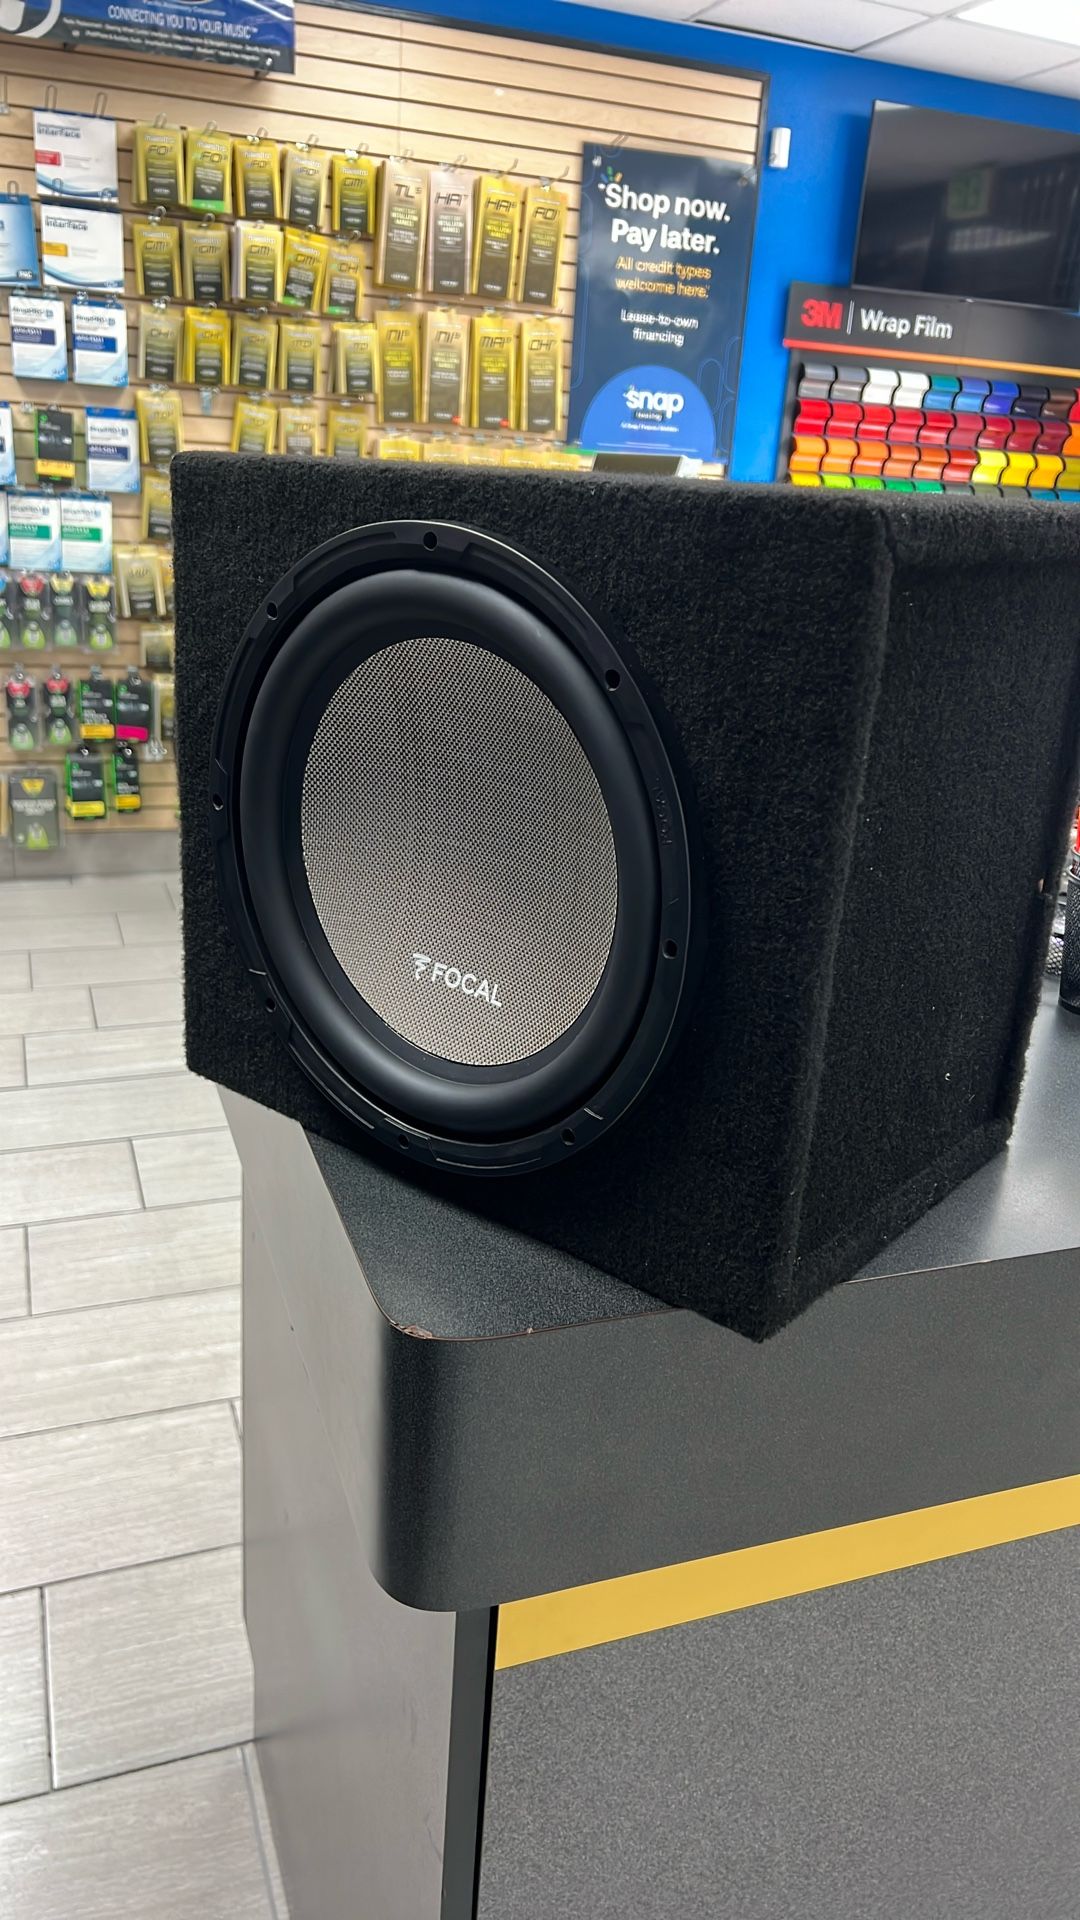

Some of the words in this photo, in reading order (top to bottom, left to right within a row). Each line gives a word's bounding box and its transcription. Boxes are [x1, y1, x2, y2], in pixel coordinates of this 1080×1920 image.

[108, 4, 164, 26] CONNECTING
[166, 14, 185, 30] YOU
[186, 17, 197, 31] TO
[199, 19, 223, 35] YOUR
[605, 183, 671, 219] Shop
[674, 196, 731, 222] now.
[611, 218, 658, 253] Pay
[660, 223, 720, 255] later.
[616, 255, 634, 271] All
[635, 259, 674, 276] credit
[675, 262, 712, 281] types
[615, 277, 676, 296] welcome
[620, 308, 699, 329] Lease-to-own
[800, 298, 844, 330] 3M
[860, 308, 911, 339] Wrap
[913, 314, 953, 340] Film
[632, 327, 685, 348] financing
[624, 389, 684, 420] snap
[431, 961, 503, 1008] FOCAL
